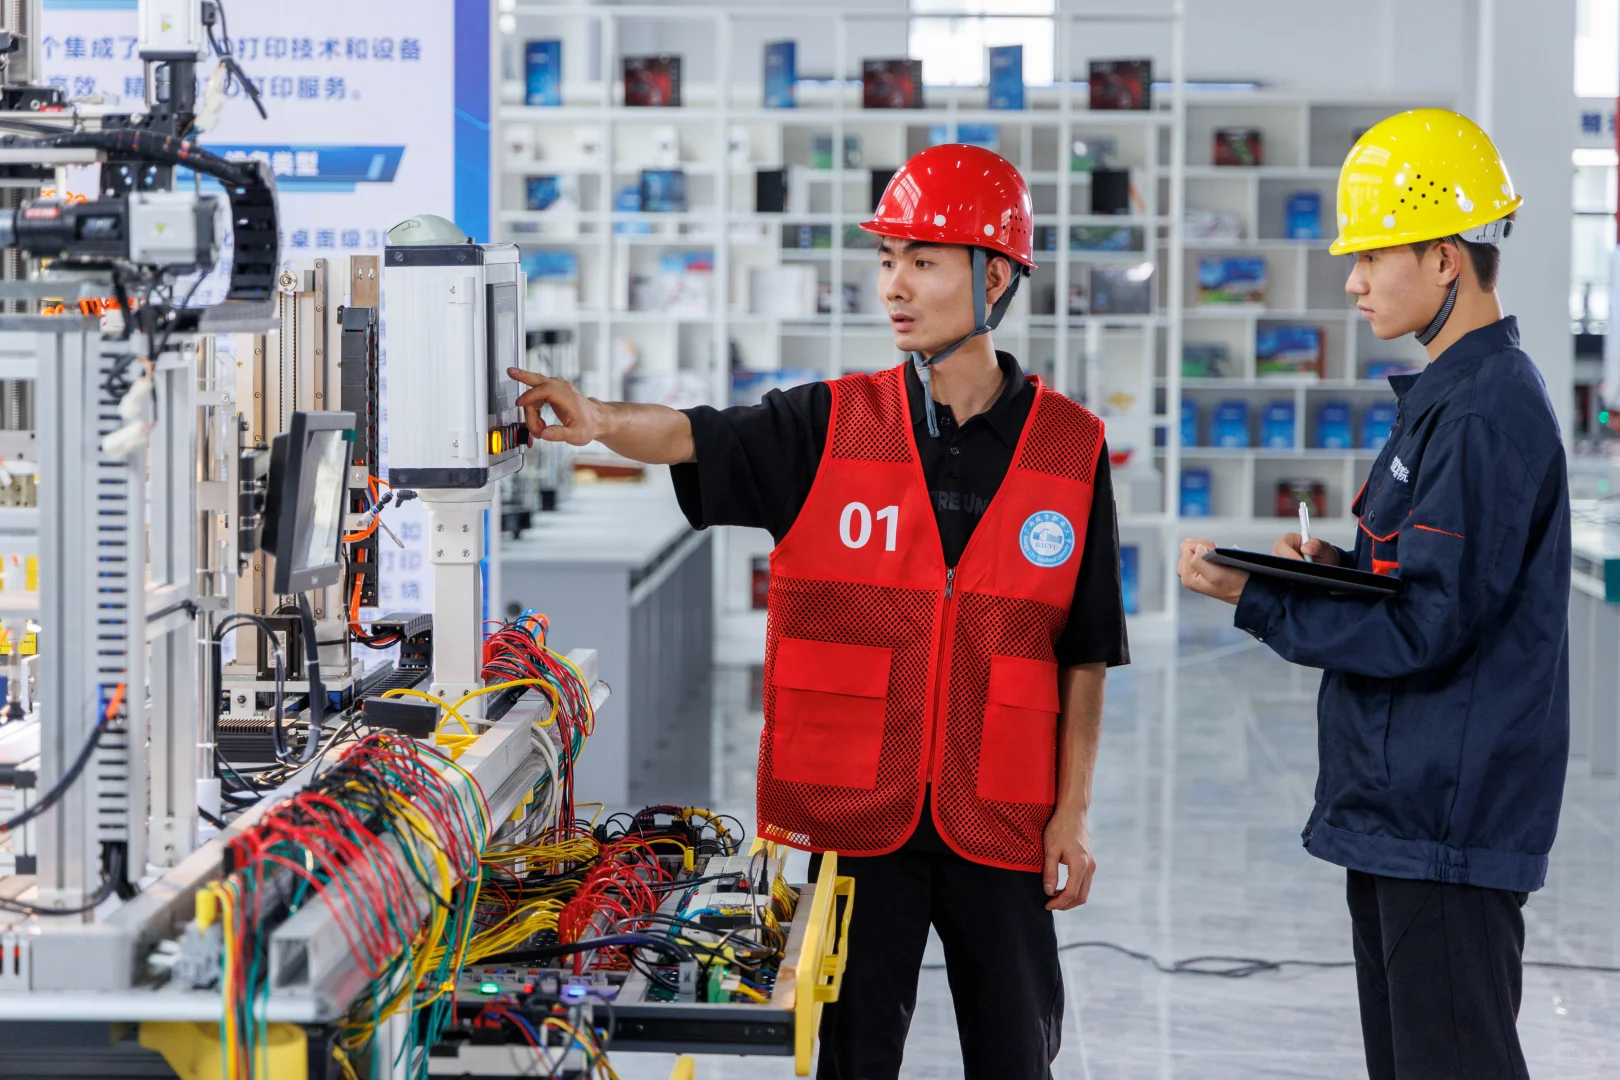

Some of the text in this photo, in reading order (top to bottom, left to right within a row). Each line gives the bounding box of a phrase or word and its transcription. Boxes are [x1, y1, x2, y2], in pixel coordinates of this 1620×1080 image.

[42, 36, 420, 60] 个集成了 D打印技术和设备
[280, 229, 388, 248] 桌面级3
[839, 502, 899, 551] 01
